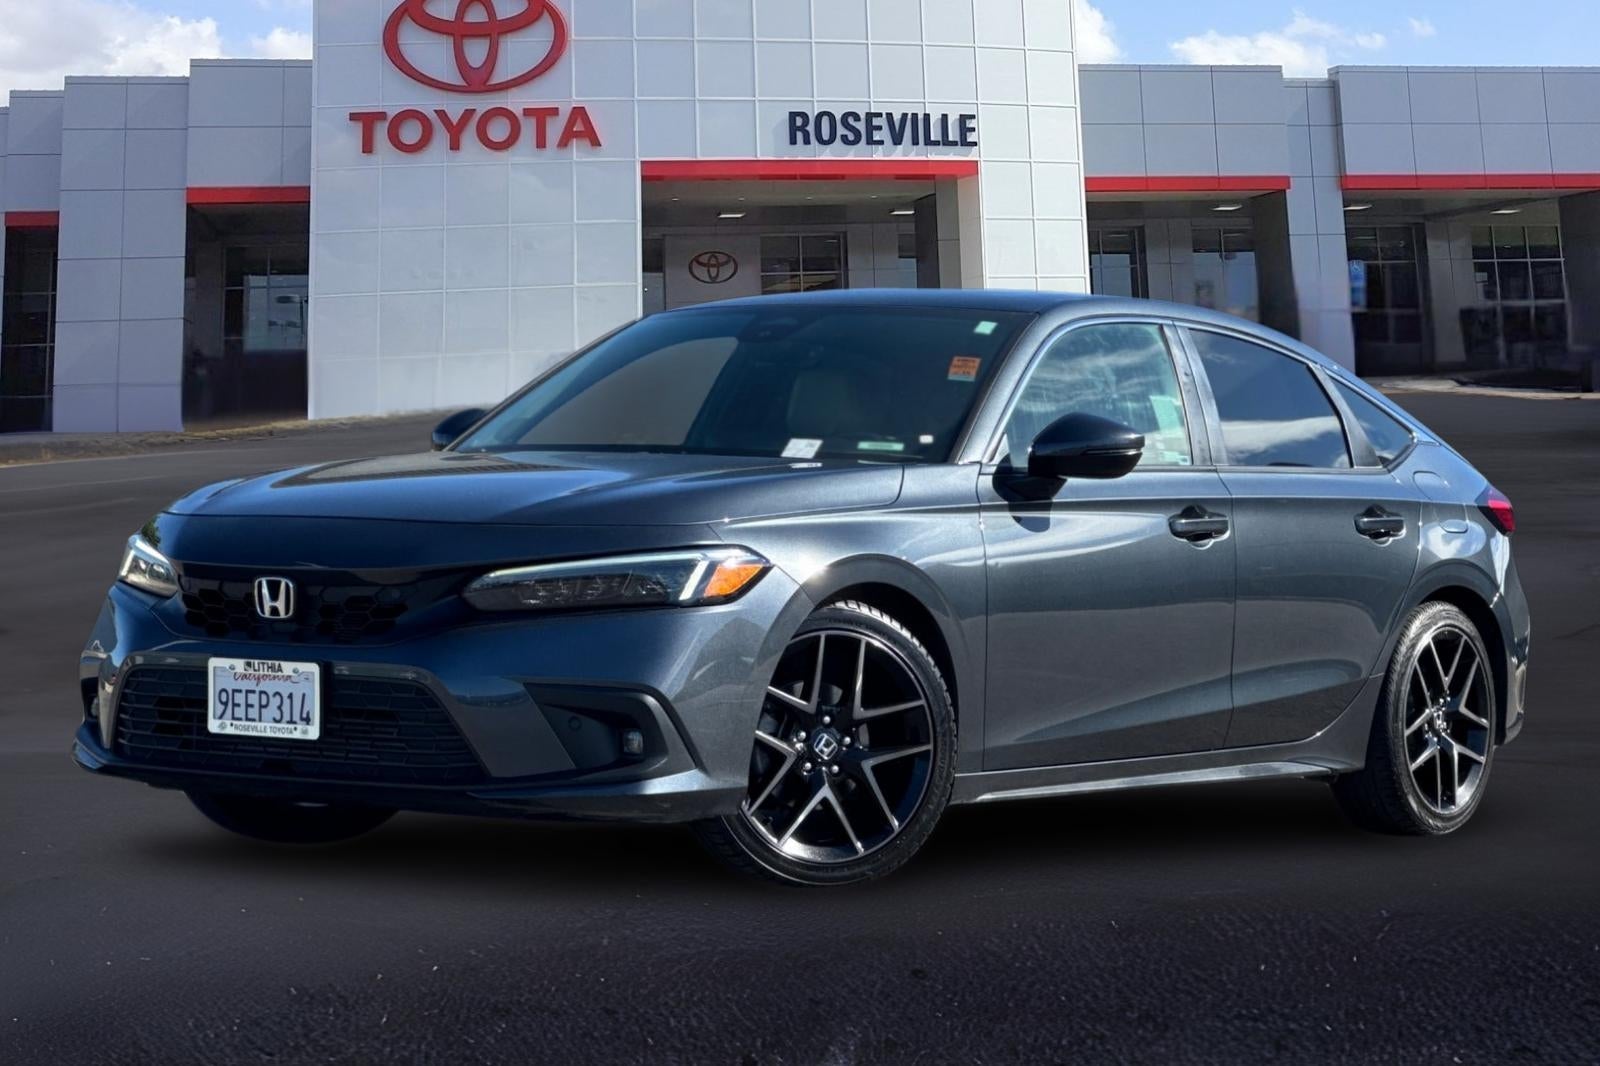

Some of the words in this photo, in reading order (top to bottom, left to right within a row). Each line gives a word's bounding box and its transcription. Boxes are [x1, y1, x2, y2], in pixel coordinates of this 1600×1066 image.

[349, 106, 602, 153] TOYOTA
[788, 110, 978, 147] ROSEVILLE
[252, 660, 284, 673] LITHIA
[217, 688, 311, 725] 9EEP314
[233, 723, 268, 734] ROSEVILLE
[269, 726, 294, 735] TOYOTA
